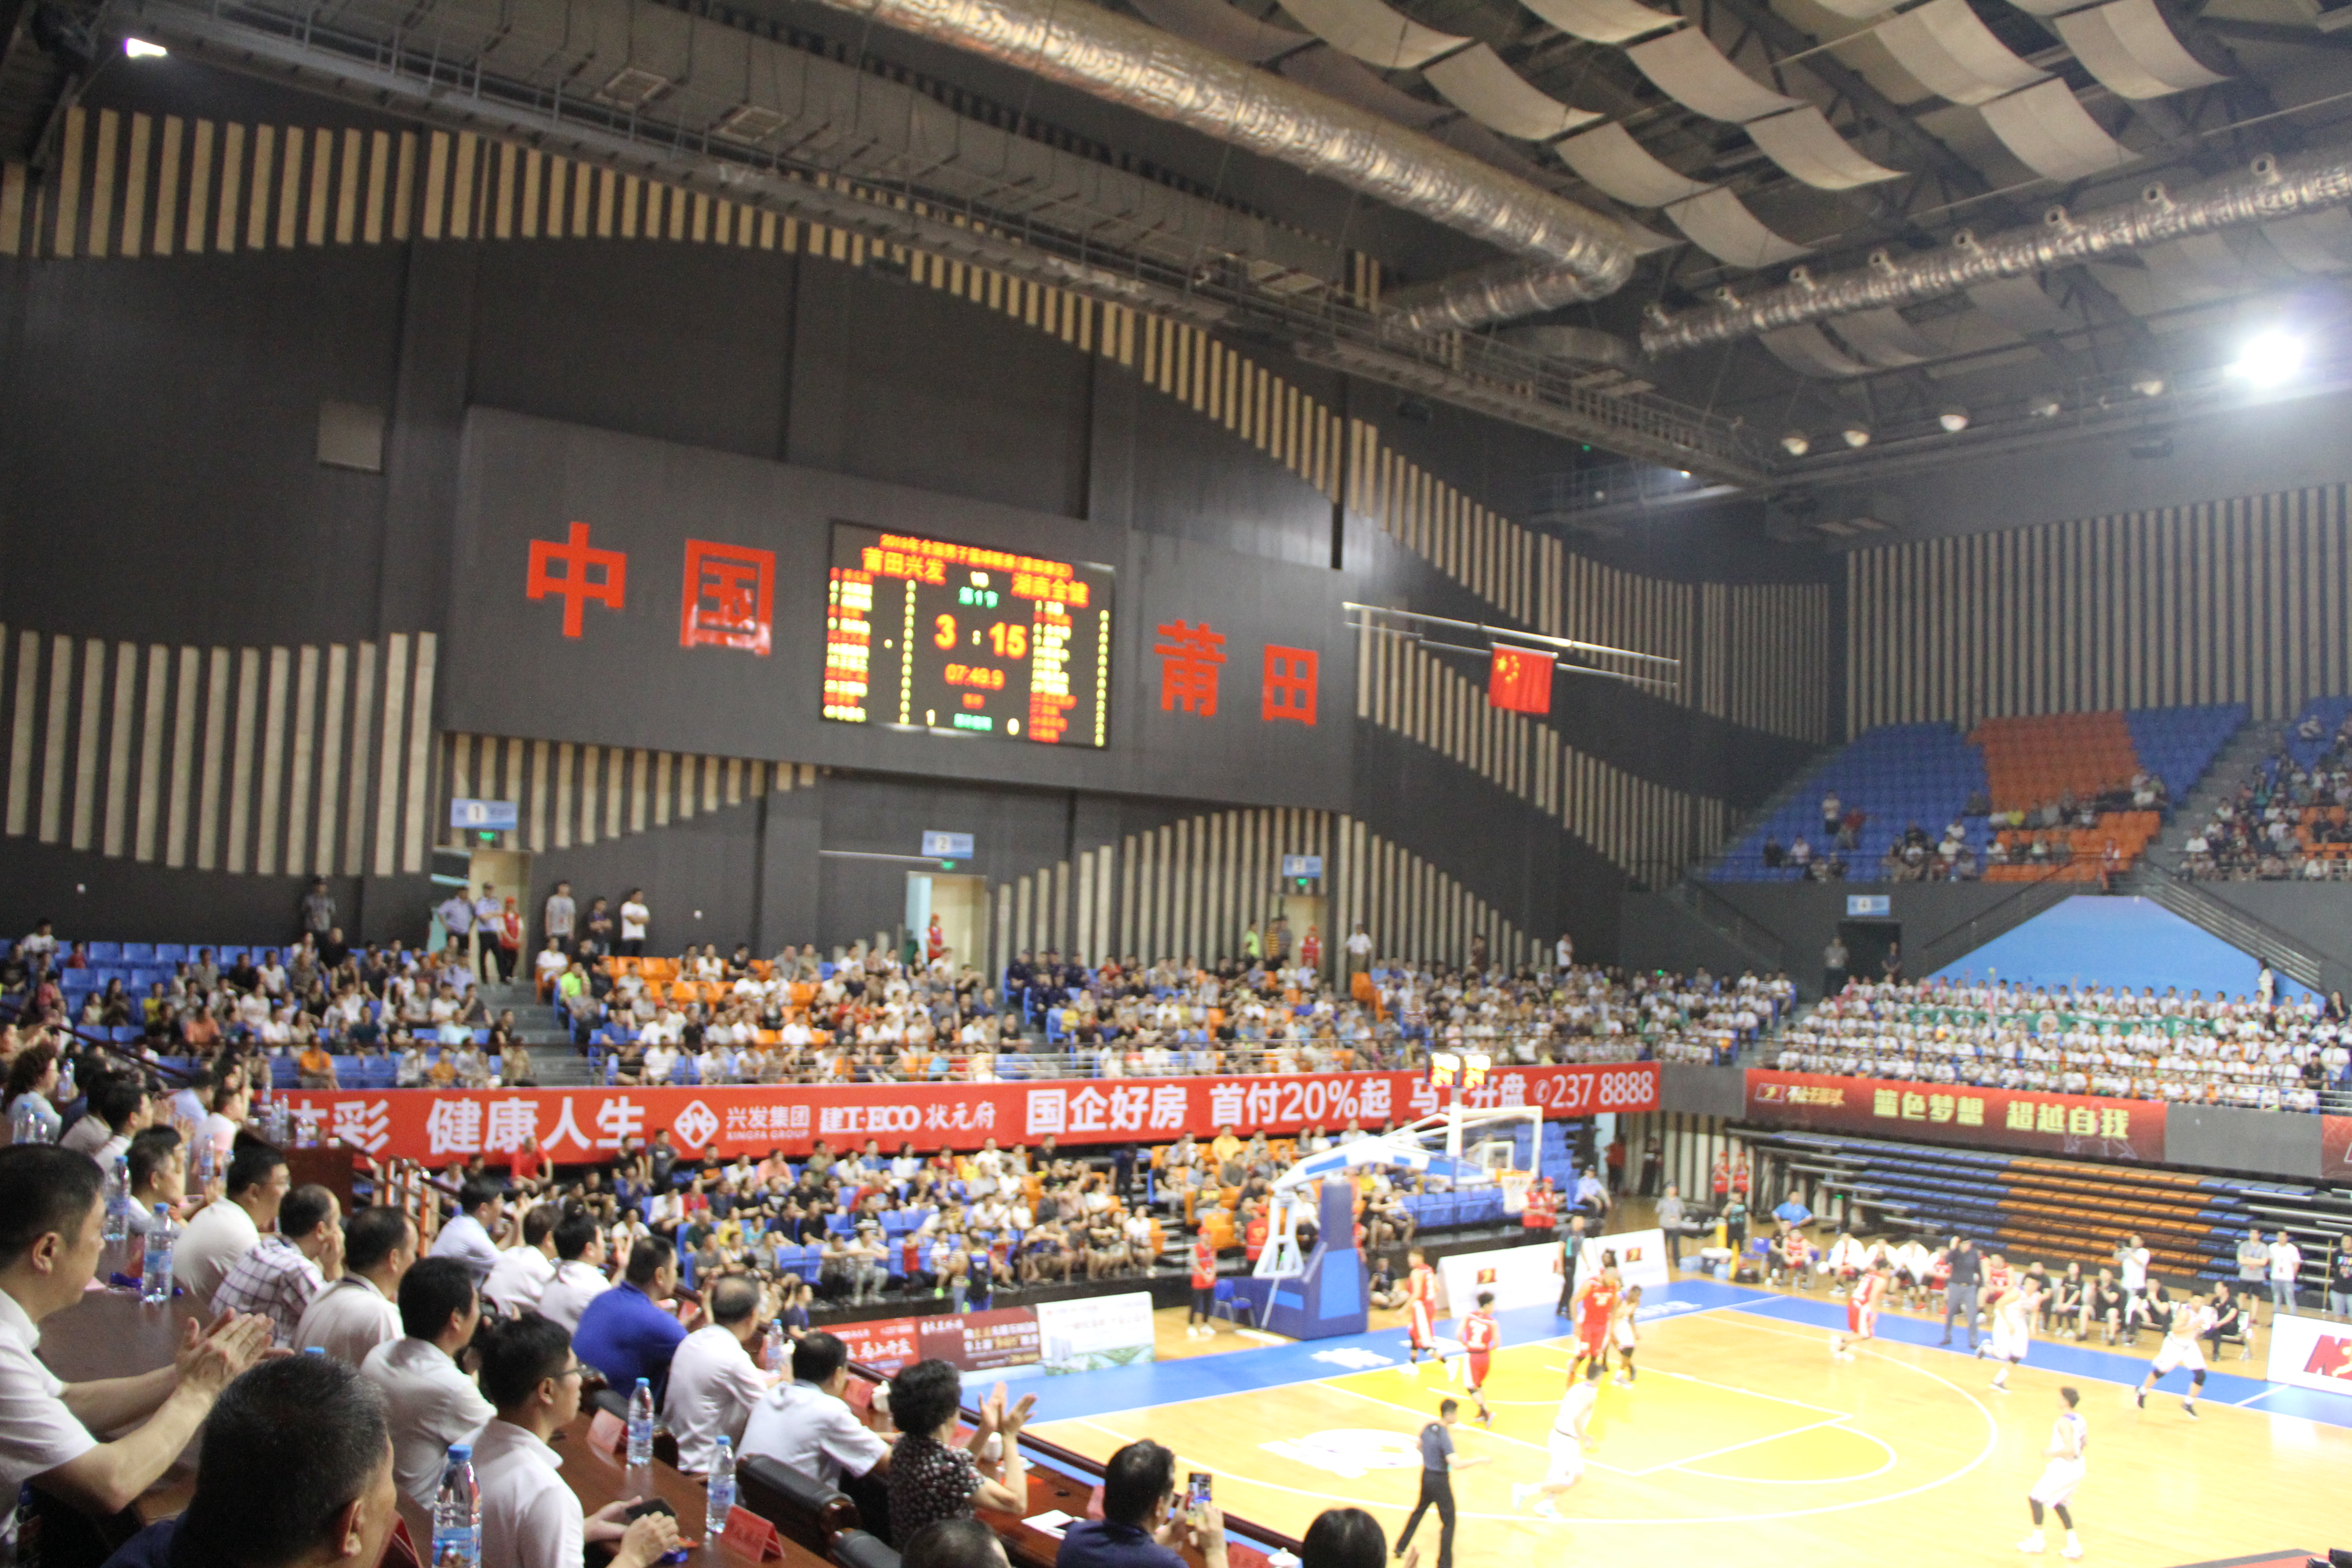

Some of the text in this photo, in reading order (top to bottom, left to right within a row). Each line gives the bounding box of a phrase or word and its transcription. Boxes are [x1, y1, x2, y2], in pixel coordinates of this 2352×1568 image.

[862, 546, 946, 585] 莆田兴发
[526, 521, 776, 655] 中国
[934, 614, 957, 650] 3
[988, 622, 1028, 659] 15
[945, 663, 1005, 690] 07:49.9
[1154, 619, 1318, 725] 莆田
[1026, 1084, 1188, 1136] 国企好房
[1210, 1078, 1391, 1127] 首付20%起
[1550, 1070, 1654, 1107] 237 8888
[426, 1096, 645, 1155] 健康人生
[726, 1104, 810, 1129] 兴发集团
[769, 1128, 810, 1140] GROUP
[2006, 1100, 2129, 1140] 超越自我
